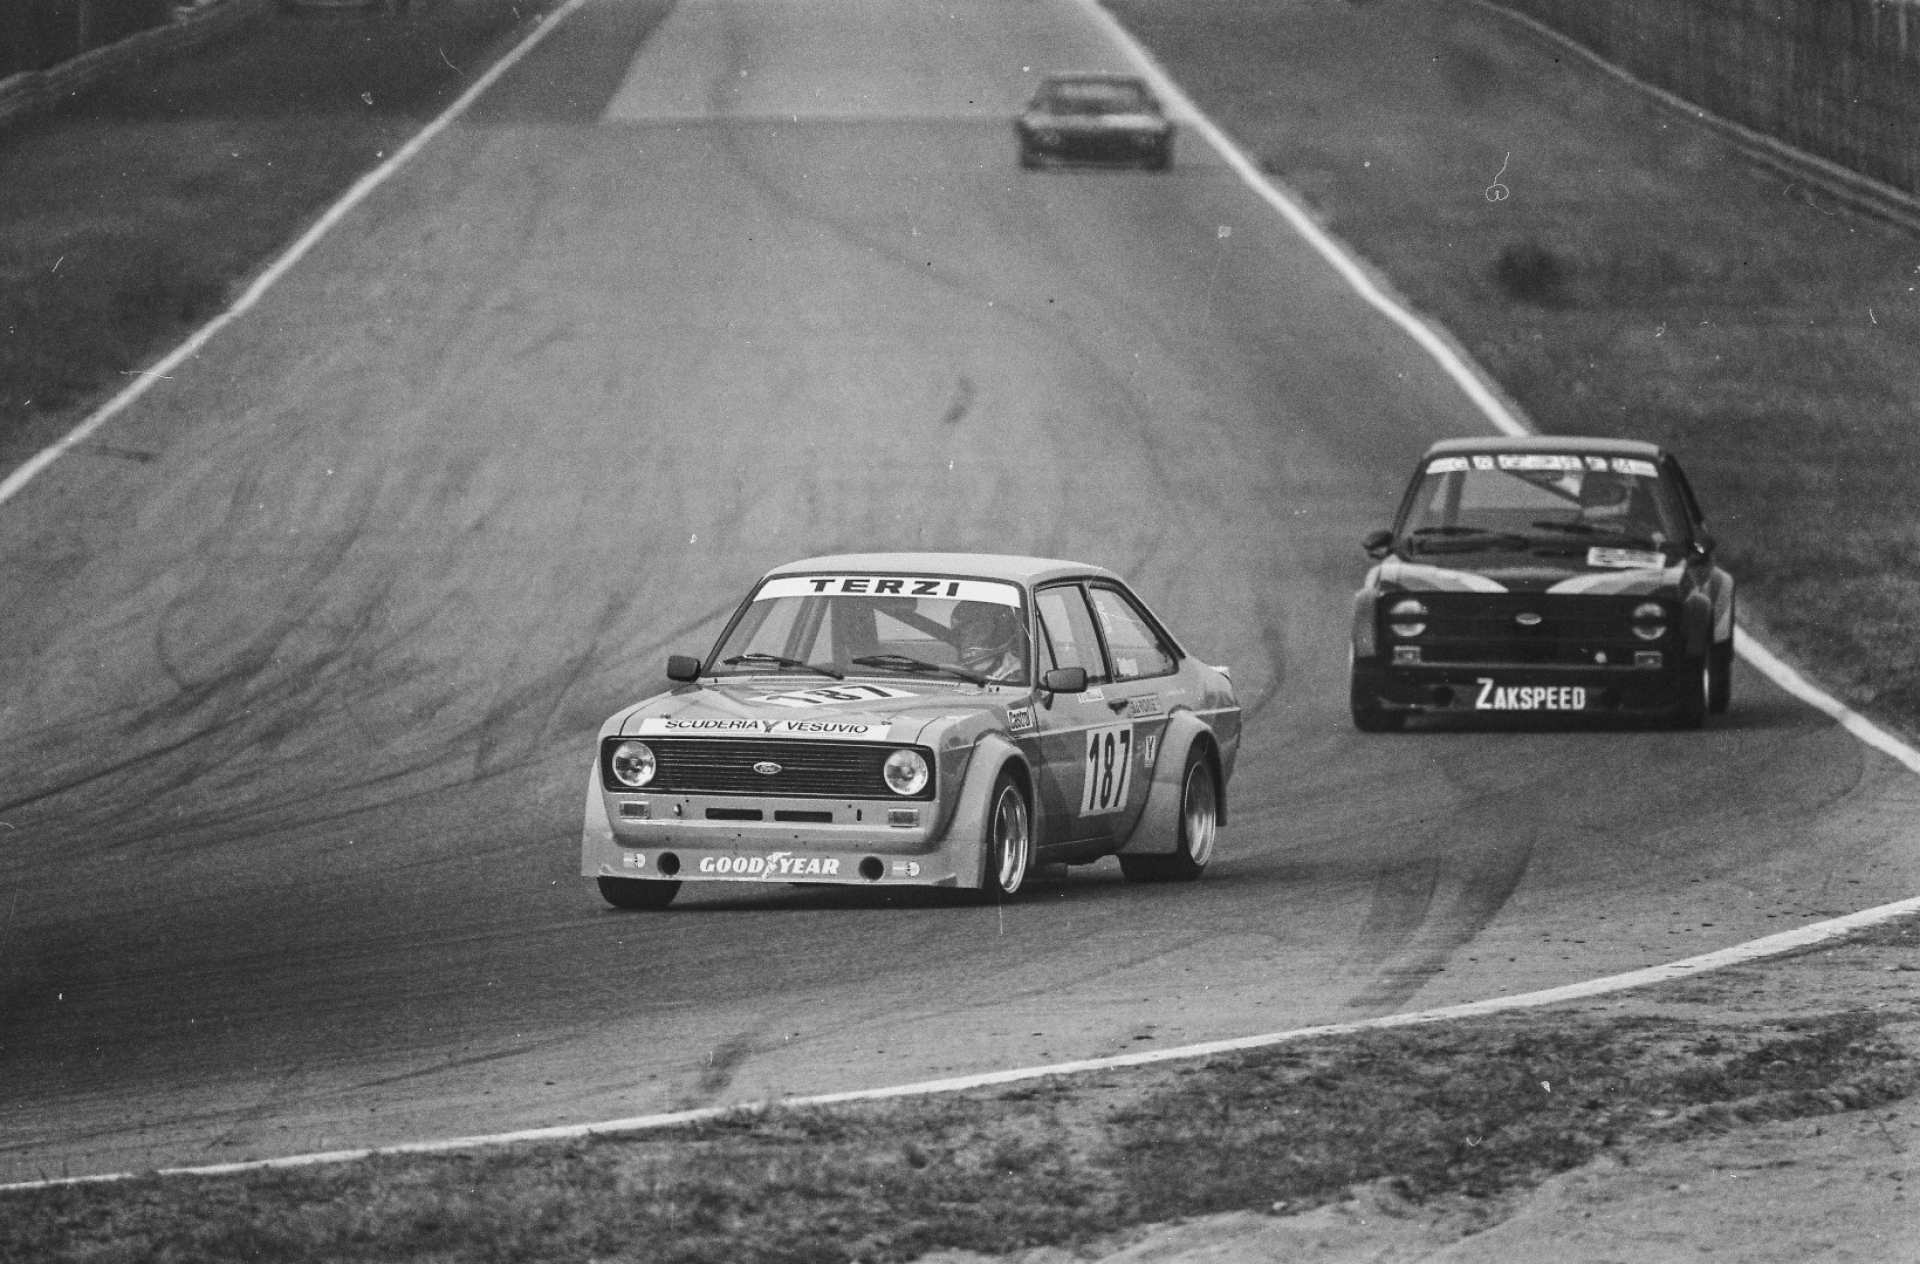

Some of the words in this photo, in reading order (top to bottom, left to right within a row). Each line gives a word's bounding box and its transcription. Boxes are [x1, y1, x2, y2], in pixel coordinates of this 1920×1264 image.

[809, 579, 960, 597] TERZI
[766, 685, 893, 704] 187
[1475, 677, 1586, 710] ZAKSPEED
[664, 719, 759, 730] SCUDERIA
[786, 721, 869, 734] VESUVIO
[1089, 729, 1132, 810] 187
